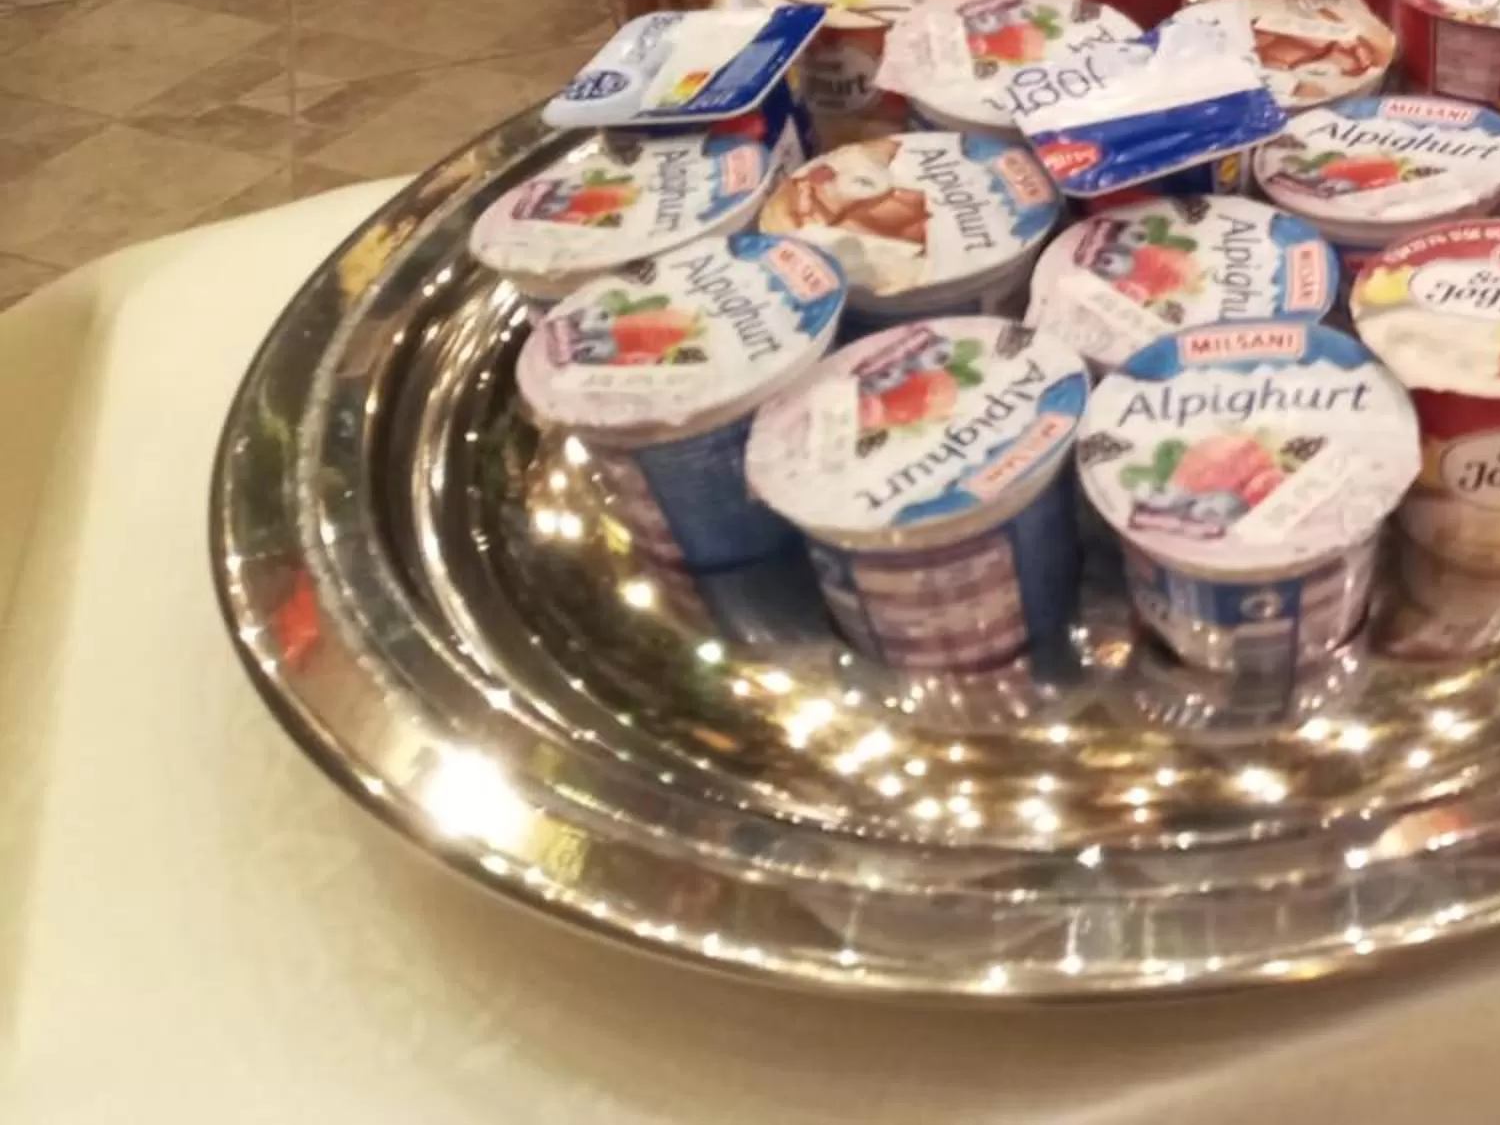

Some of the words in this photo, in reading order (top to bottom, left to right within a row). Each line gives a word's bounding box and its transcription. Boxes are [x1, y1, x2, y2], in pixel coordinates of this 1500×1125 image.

[906, 146, 997, 253] Alpighurt
[669, 253, 782, 363] Alpighurt
[1190, 332, 1295, 355] MILSANI
[855, 359, 1046, 512] Alpighurt
[1118, 377, 1373, 428] Alpighurt
